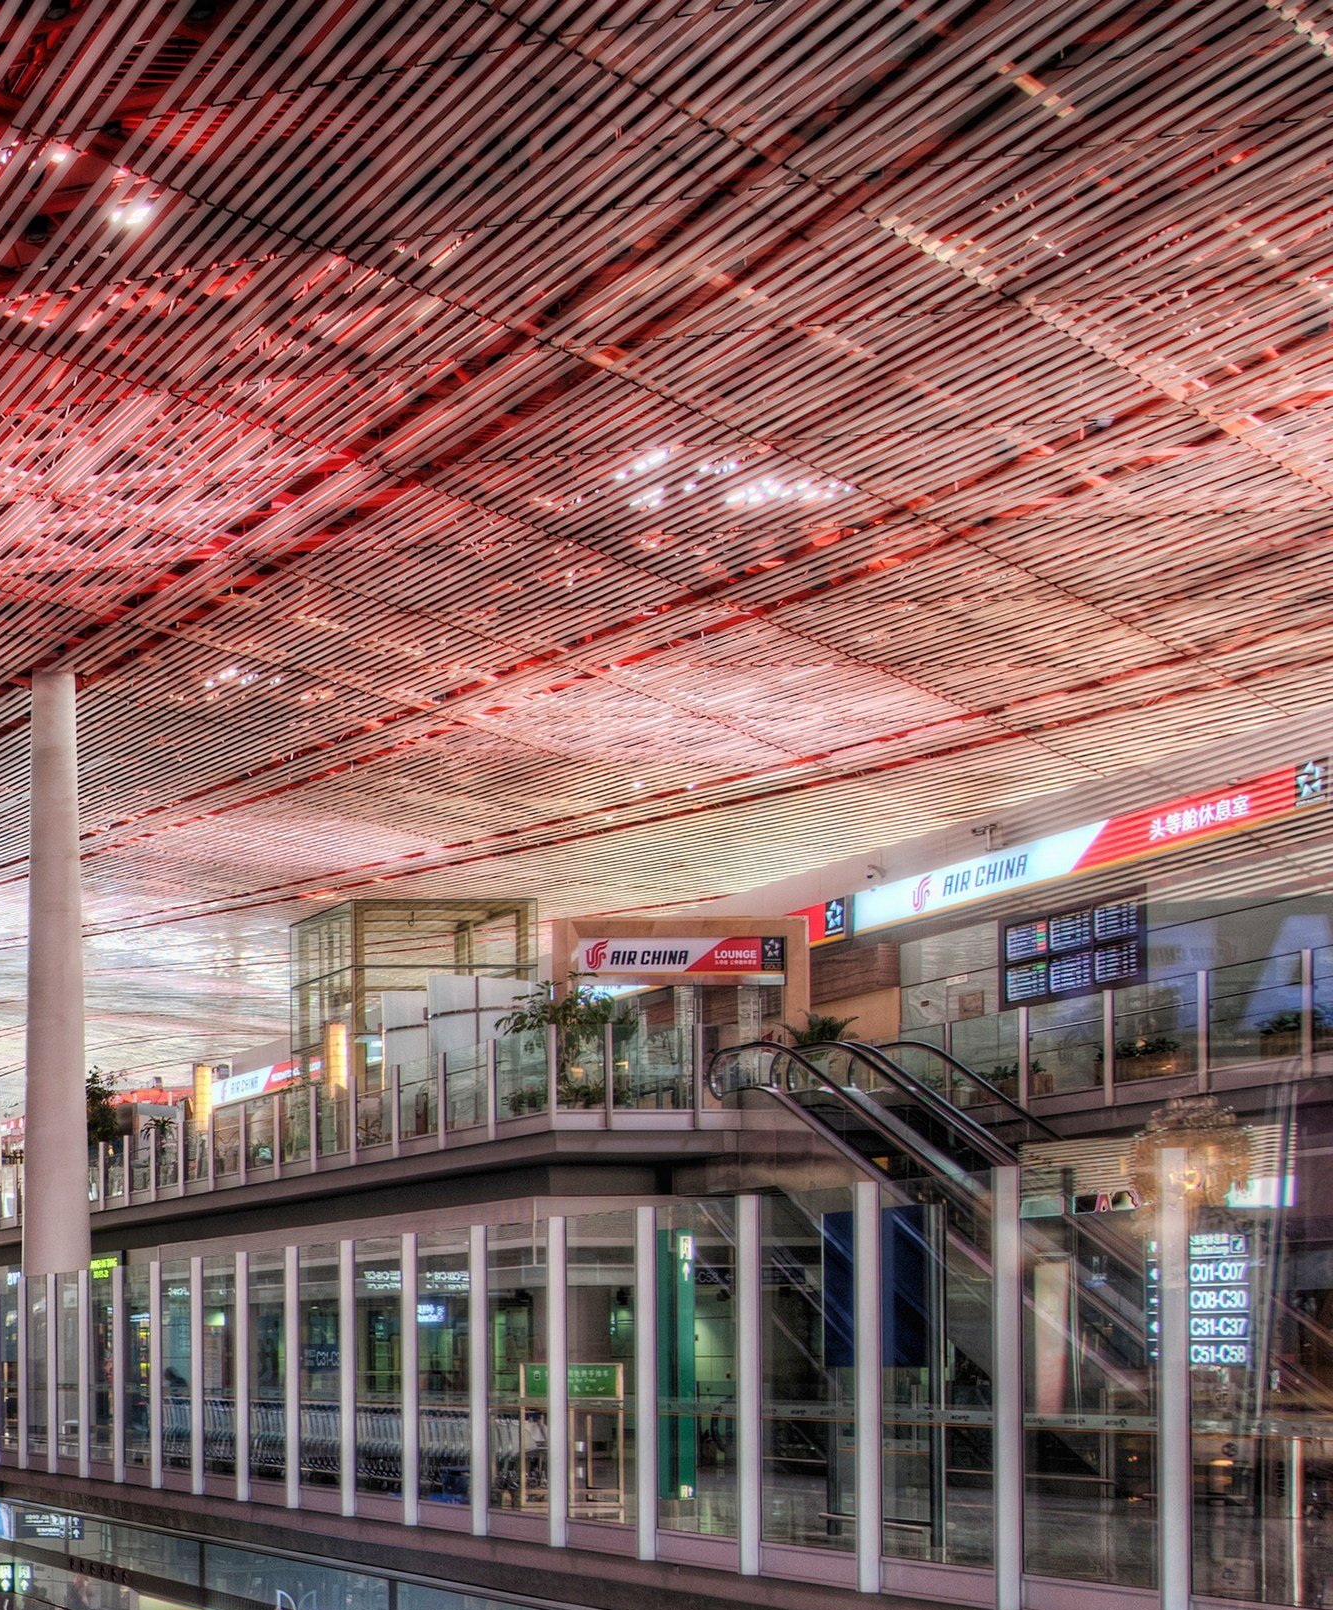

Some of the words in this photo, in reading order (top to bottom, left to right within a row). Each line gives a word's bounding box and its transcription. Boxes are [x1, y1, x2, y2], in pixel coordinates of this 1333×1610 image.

[1149, 795, 1250, 841] 头等舱休息室
[943, 870, 970, 896] AIR
[975, 854, 1028, 887] CHINA
[610, 950, 637, 965] AIR
[640, 949, 689, 965] CHINA
[714, 949, 758, 959] LOUNGE
[764, 963, 782, 971] GOLD
[1190, 1262, 1246, 1281] C01-C07
[1190, 1290, 1247, 1309] C08-C30
[1190, 1317, 1247, 1336] C31-C37
[316, 1351, 342, 1367] C31-C3
[1190, 1345, 1247, 1363] C51-C58
[1276, 1461, 1285, 1498] waste
